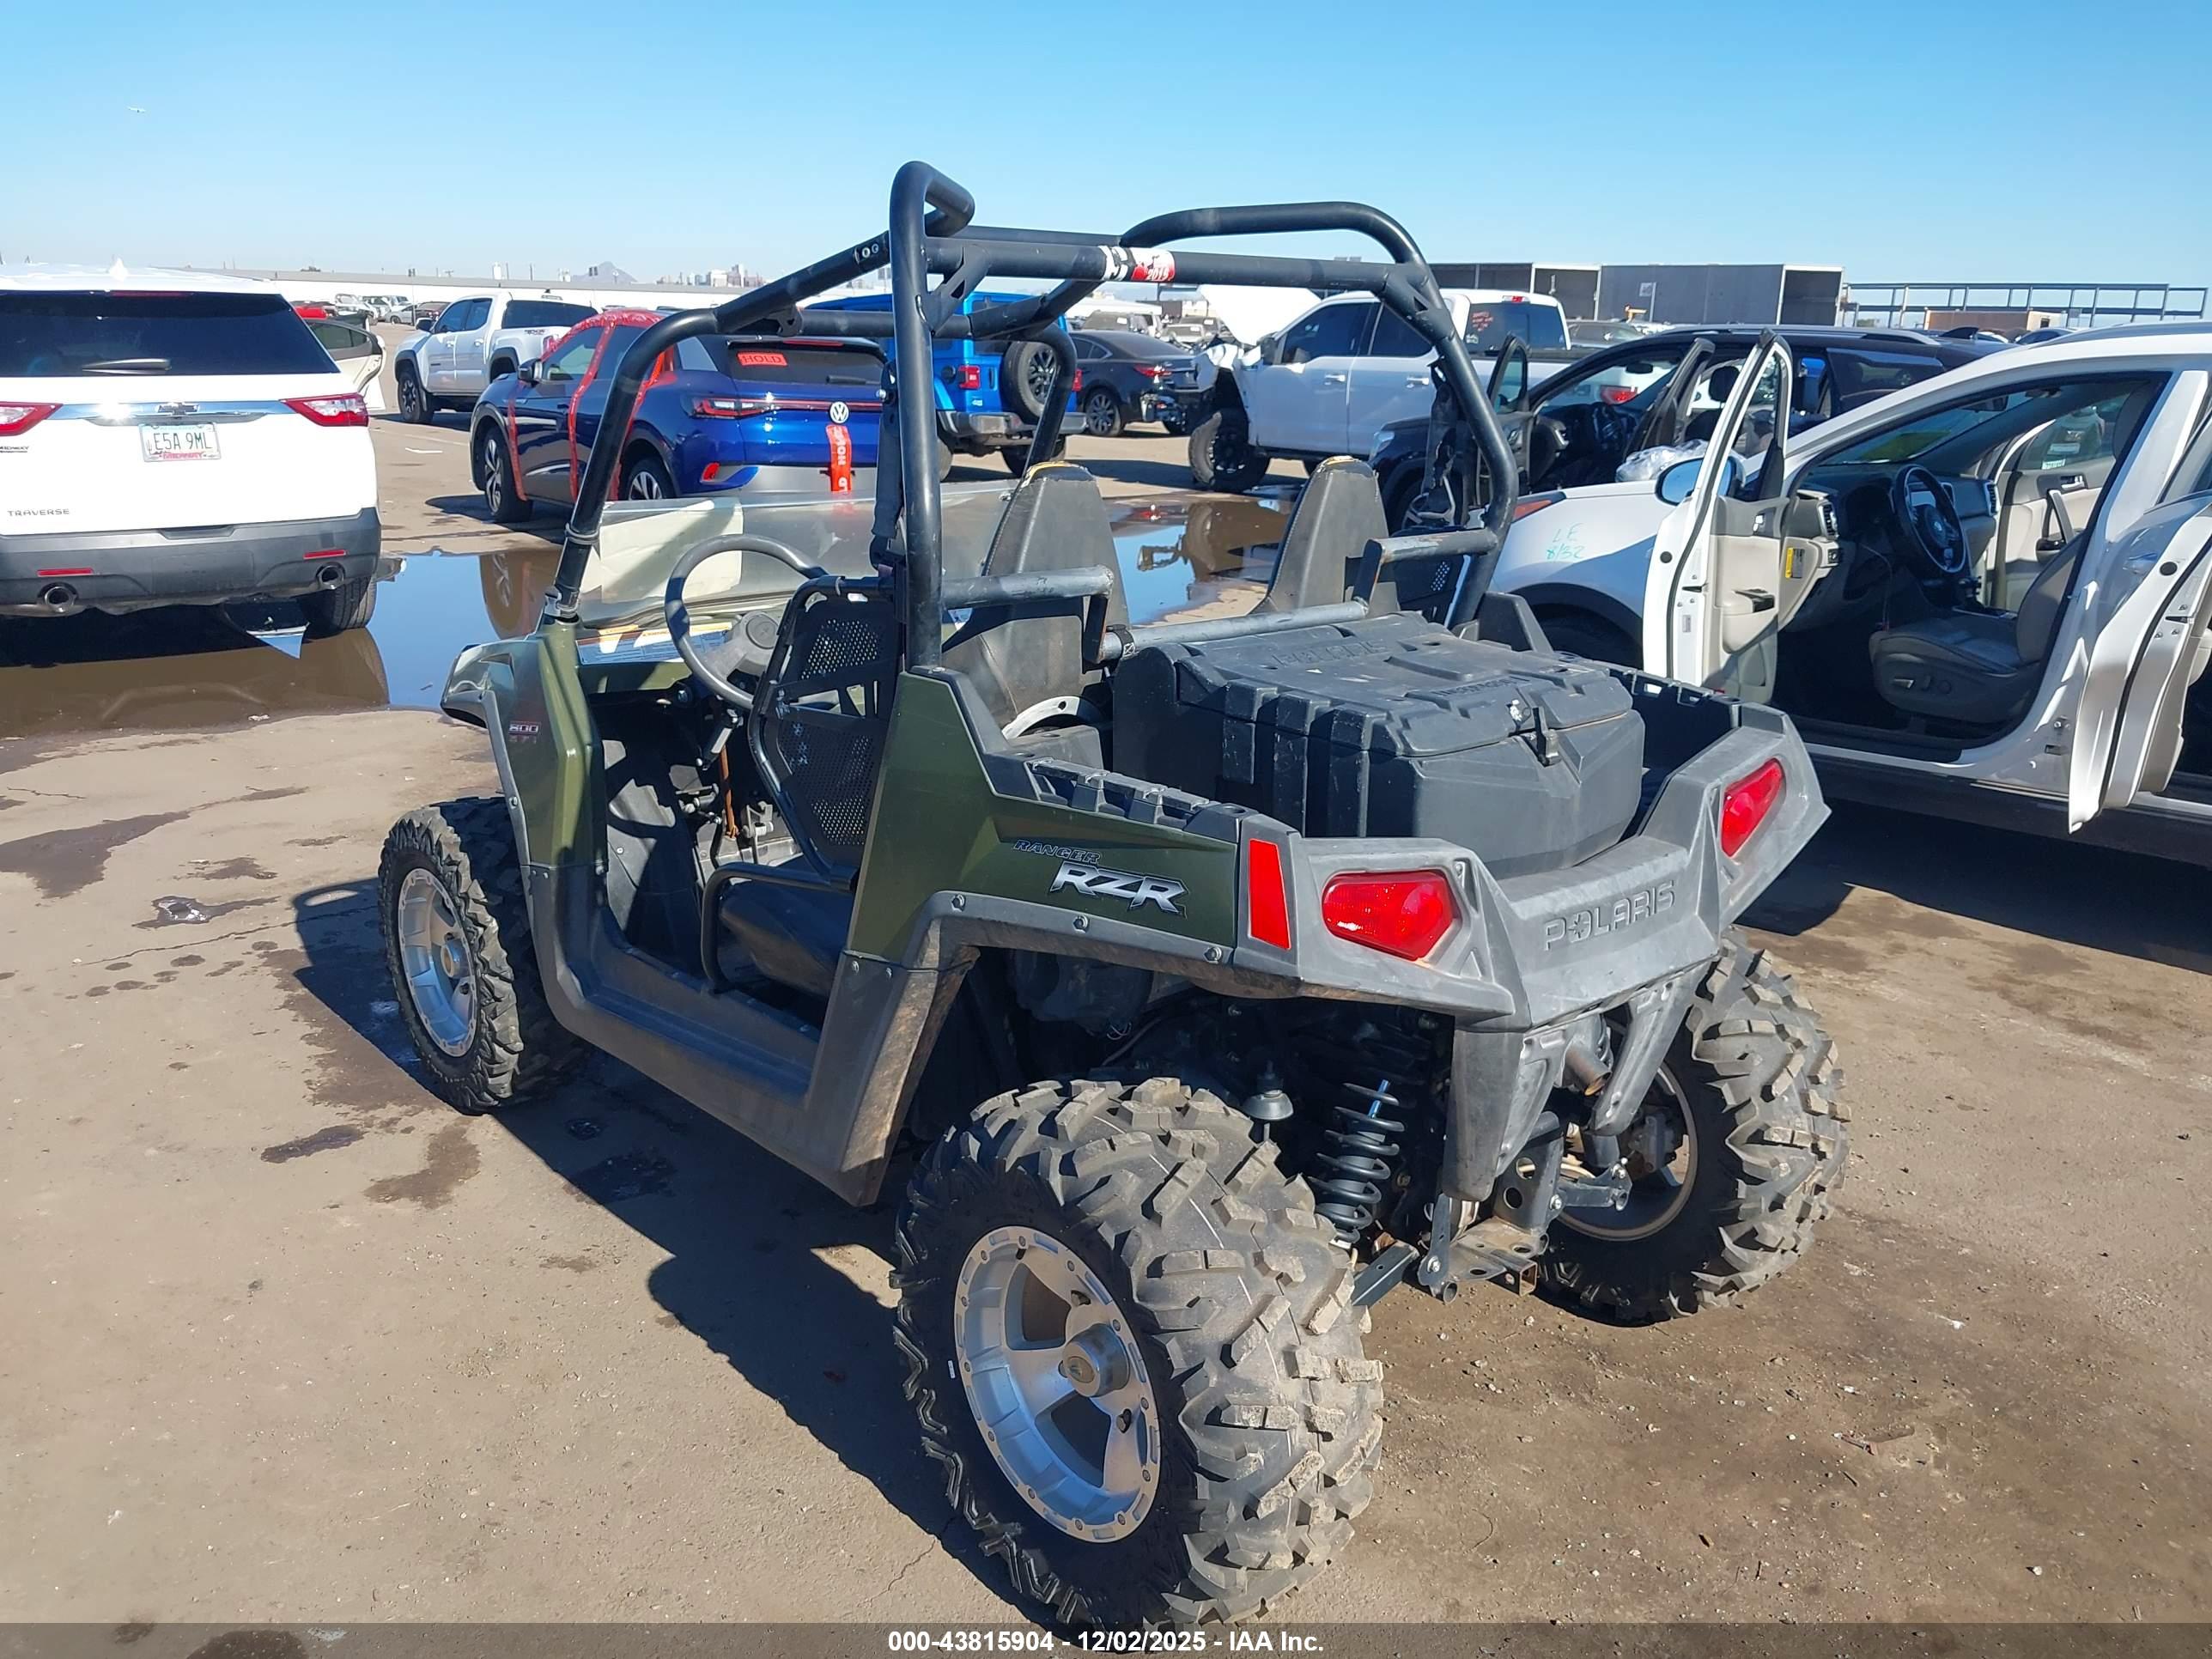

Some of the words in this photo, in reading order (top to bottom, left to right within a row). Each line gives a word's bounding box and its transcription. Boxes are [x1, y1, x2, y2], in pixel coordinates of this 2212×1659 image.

[741, 355, 783, 363] HOLD
[153, 432, 182, 450] E5A
[185, 432, 214, 450] 9ML
[7, 508, 70, 517] TRAVERSE
[508, 723, 539, 732] 800
[1012, 839, 1102, 865] RANGER
[1048, 860, 1188, 917] RZR
[1544, 880, 1675, 951] POLARIS
